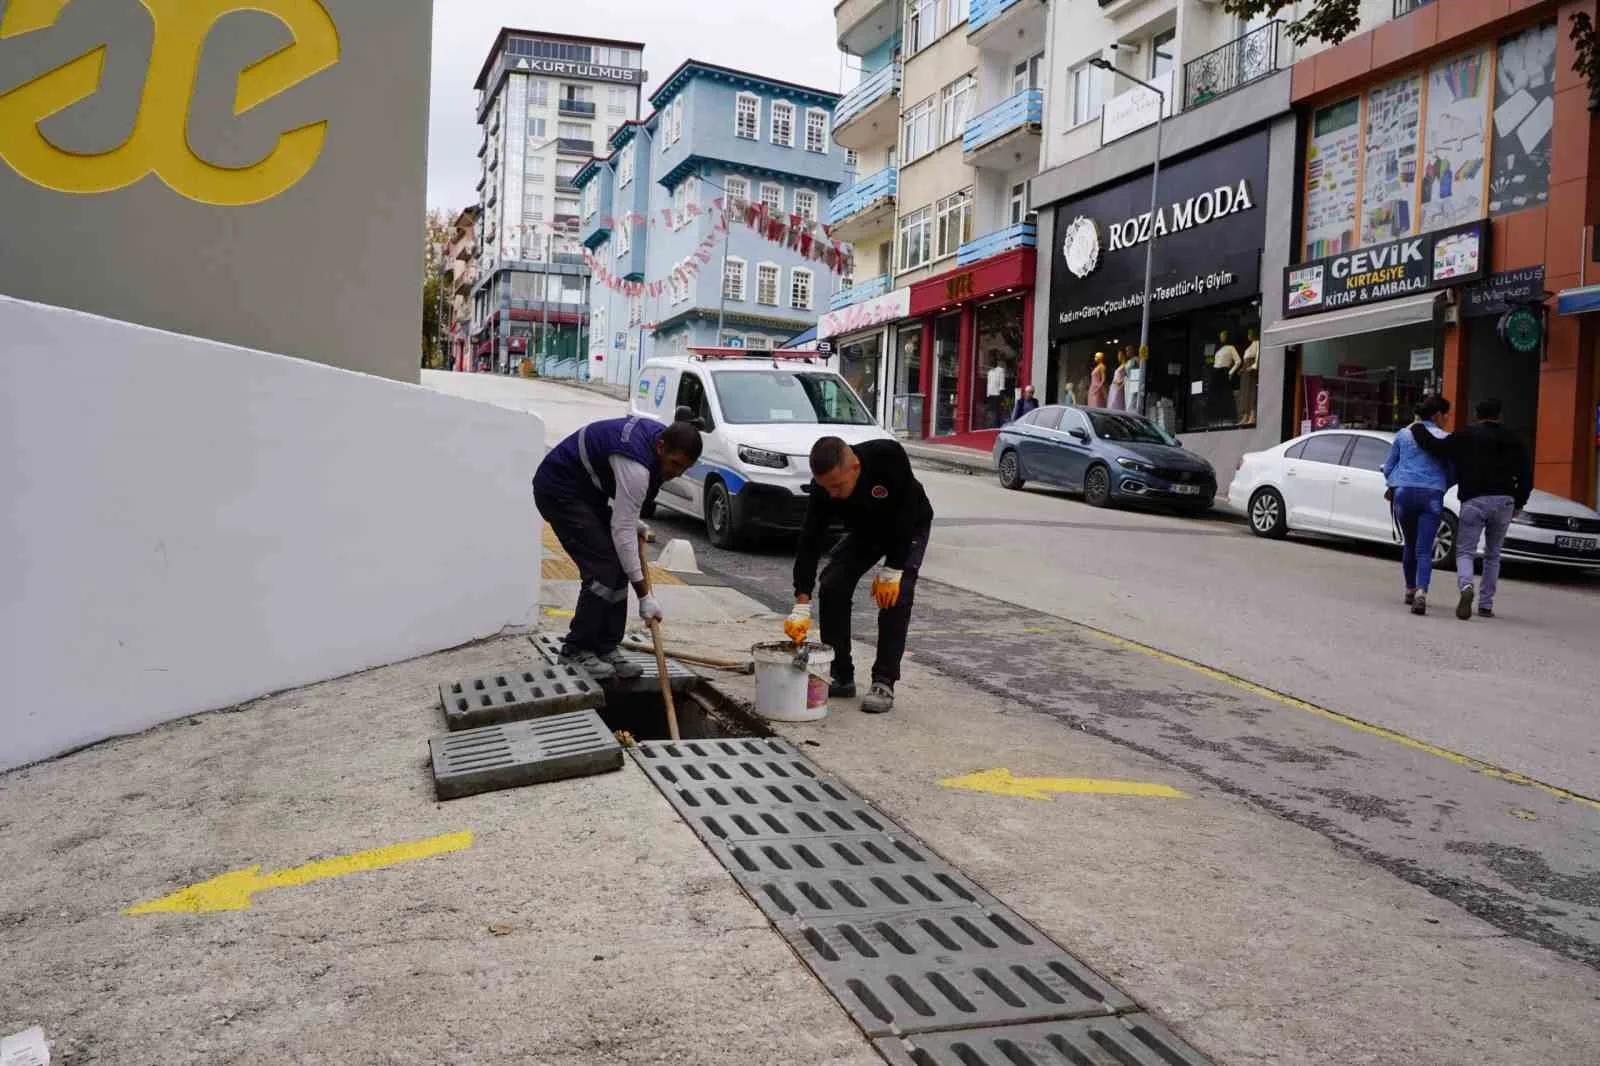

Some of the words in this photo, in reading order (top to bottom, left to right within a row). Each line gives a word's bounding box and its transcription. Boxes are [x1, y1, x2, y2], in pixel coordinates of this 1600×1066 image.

[1109, 208, 1168, 251] ROZA
[1172, 178, 1252, 233] MODA
[1359, 288, 1368, 300] &
[1371, 275, 1427, 298] AMBALAJ
